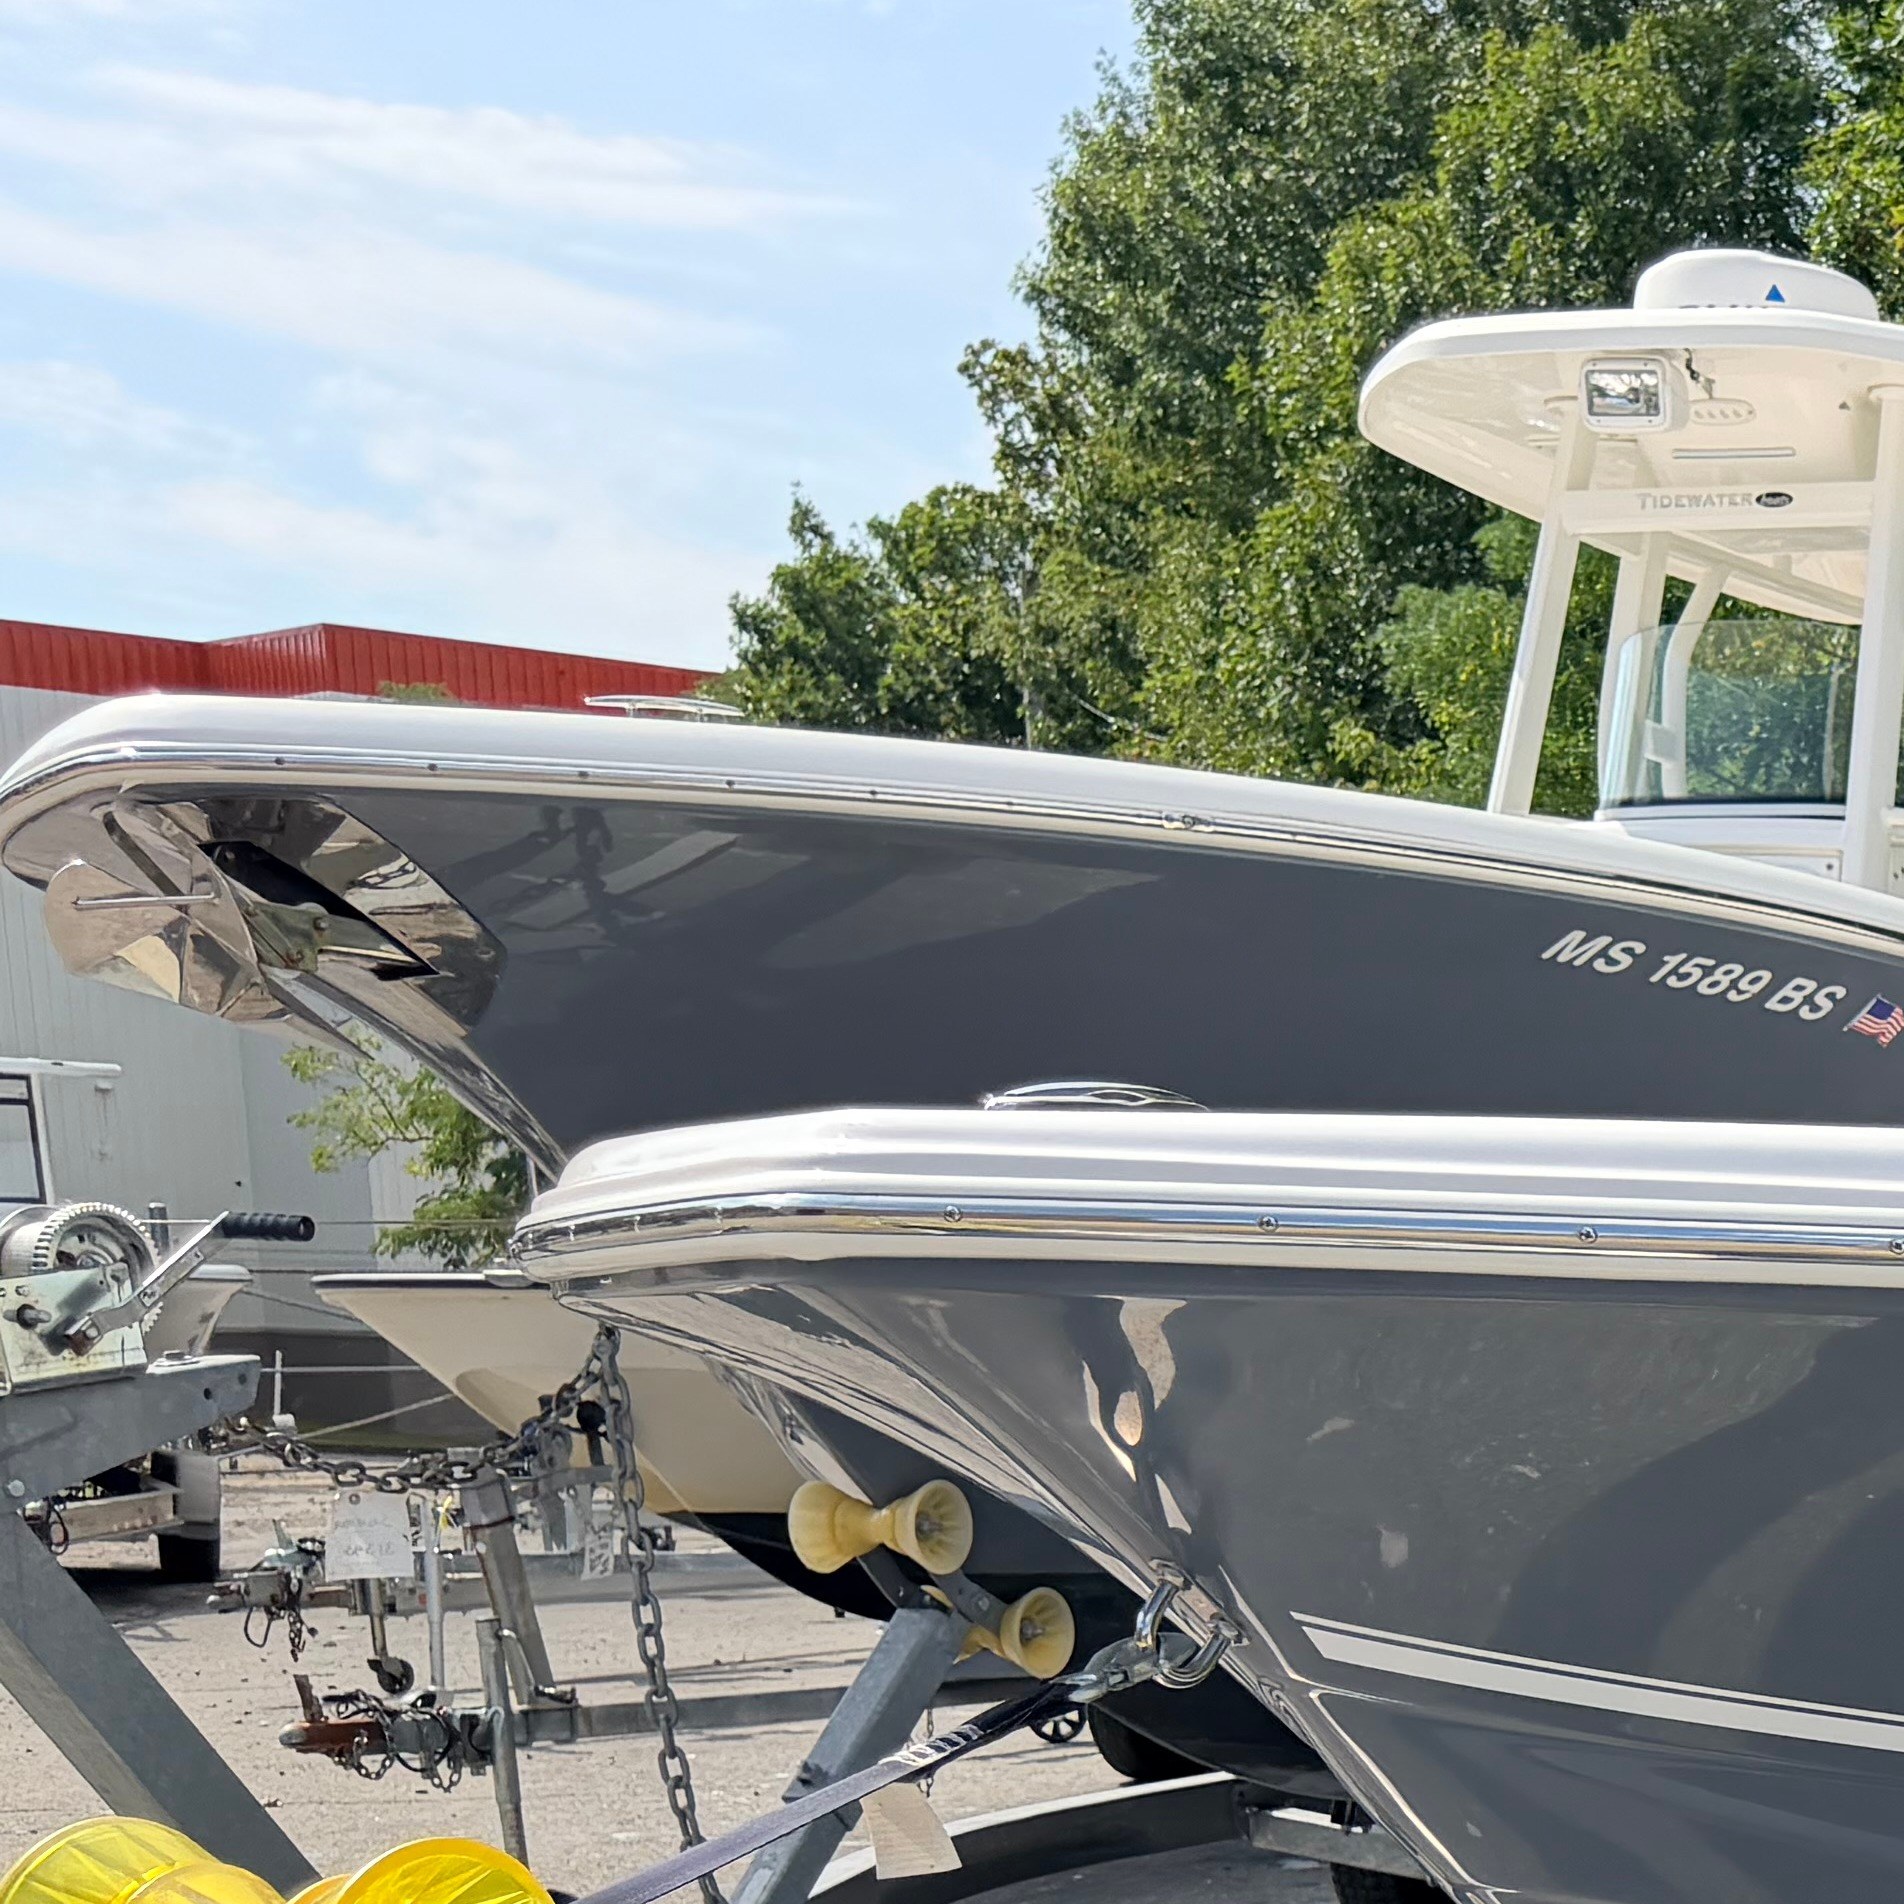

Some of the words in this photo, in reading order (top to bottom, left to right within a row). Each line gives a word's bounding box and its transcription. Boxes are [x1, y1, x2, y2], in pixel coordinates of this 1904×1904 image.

[1541, 929, 1647, 974] MS
[1649, 952, 1773, 1003] 1589
[1764, 977, 1847, 1021] BS
